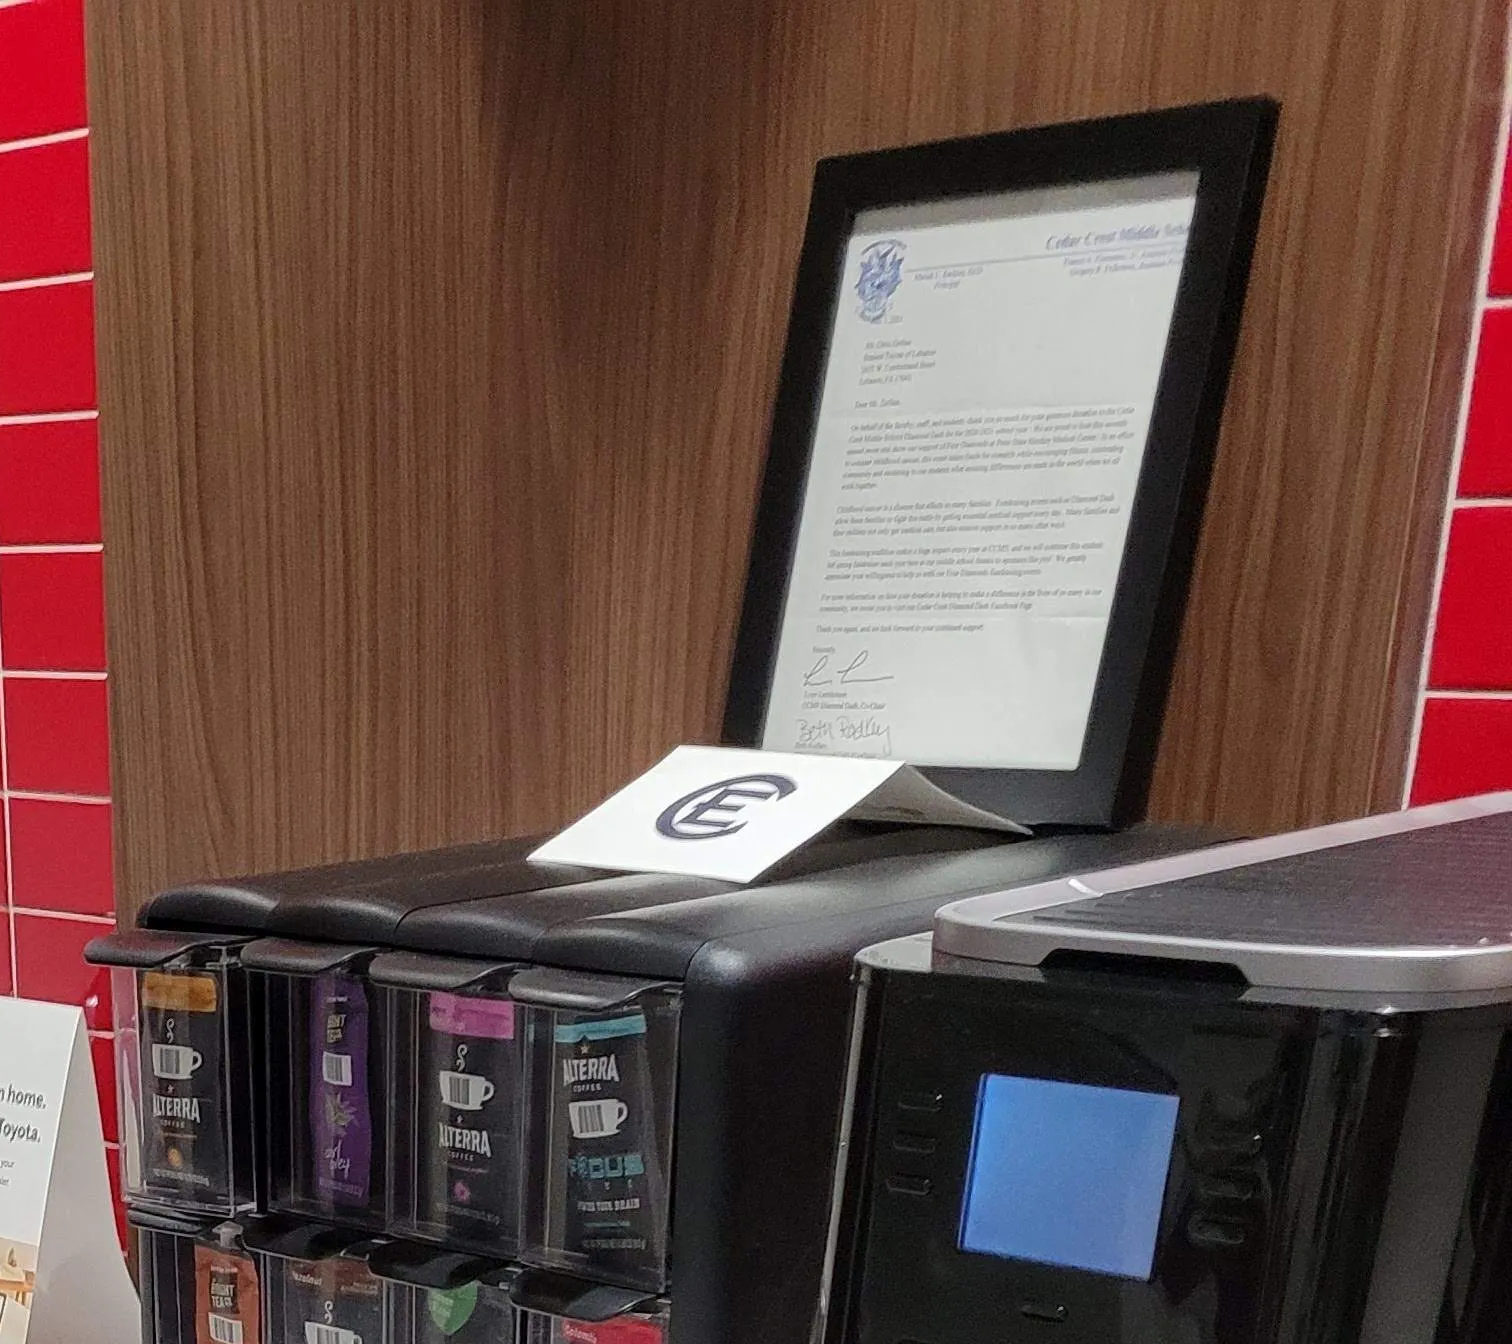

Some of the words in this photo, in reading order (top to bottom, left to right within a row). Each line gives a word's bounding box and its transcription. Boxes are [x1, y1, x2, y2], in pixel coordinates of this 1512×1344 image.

[563, 1053, 620, 1086] ALTERRA
[7, 1084, 47, 1109] home.
[152, 1093, 200, 1123] ALTERRA
[438, 1122, 492, 1158] ALTERRA
[0, 1160, 15, 1169] your
